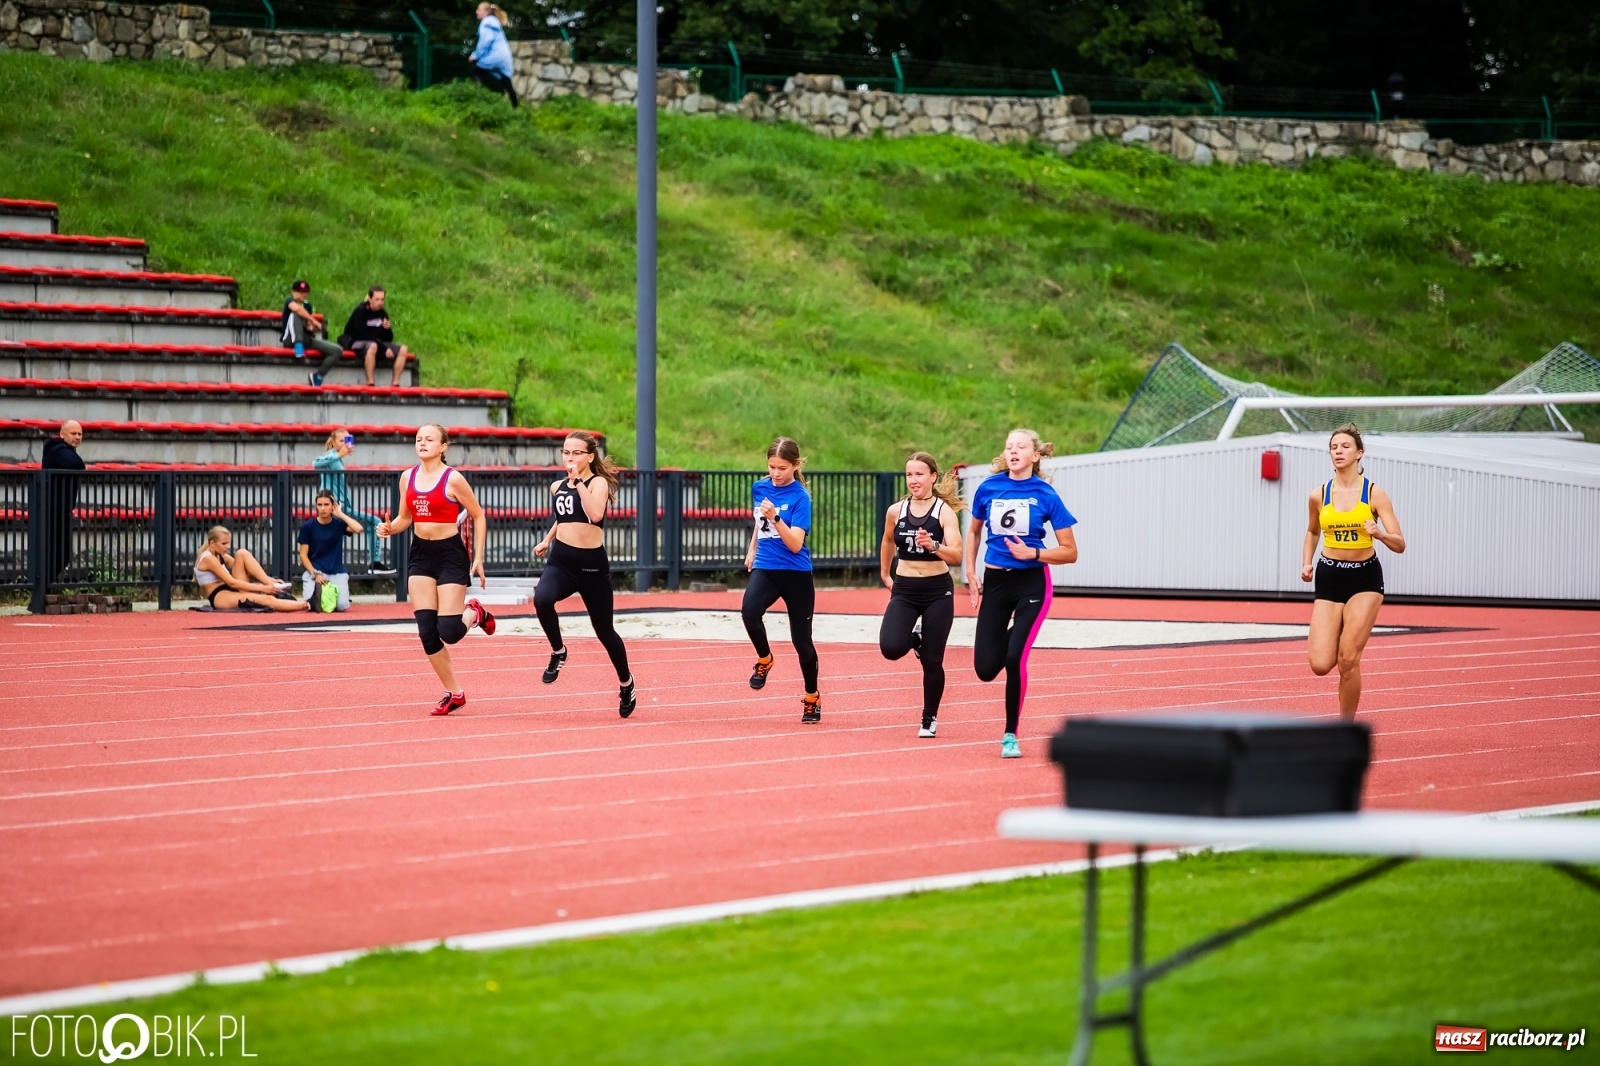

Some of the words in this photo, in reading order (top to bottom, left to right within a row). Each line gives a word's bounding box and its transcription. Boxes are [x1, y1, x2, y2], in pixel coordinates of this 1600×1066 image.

[556, 495, 574, 516] 69
[1000, 508, 1017, 529] 6
[1336, 561, 1361, 569] NIKE
